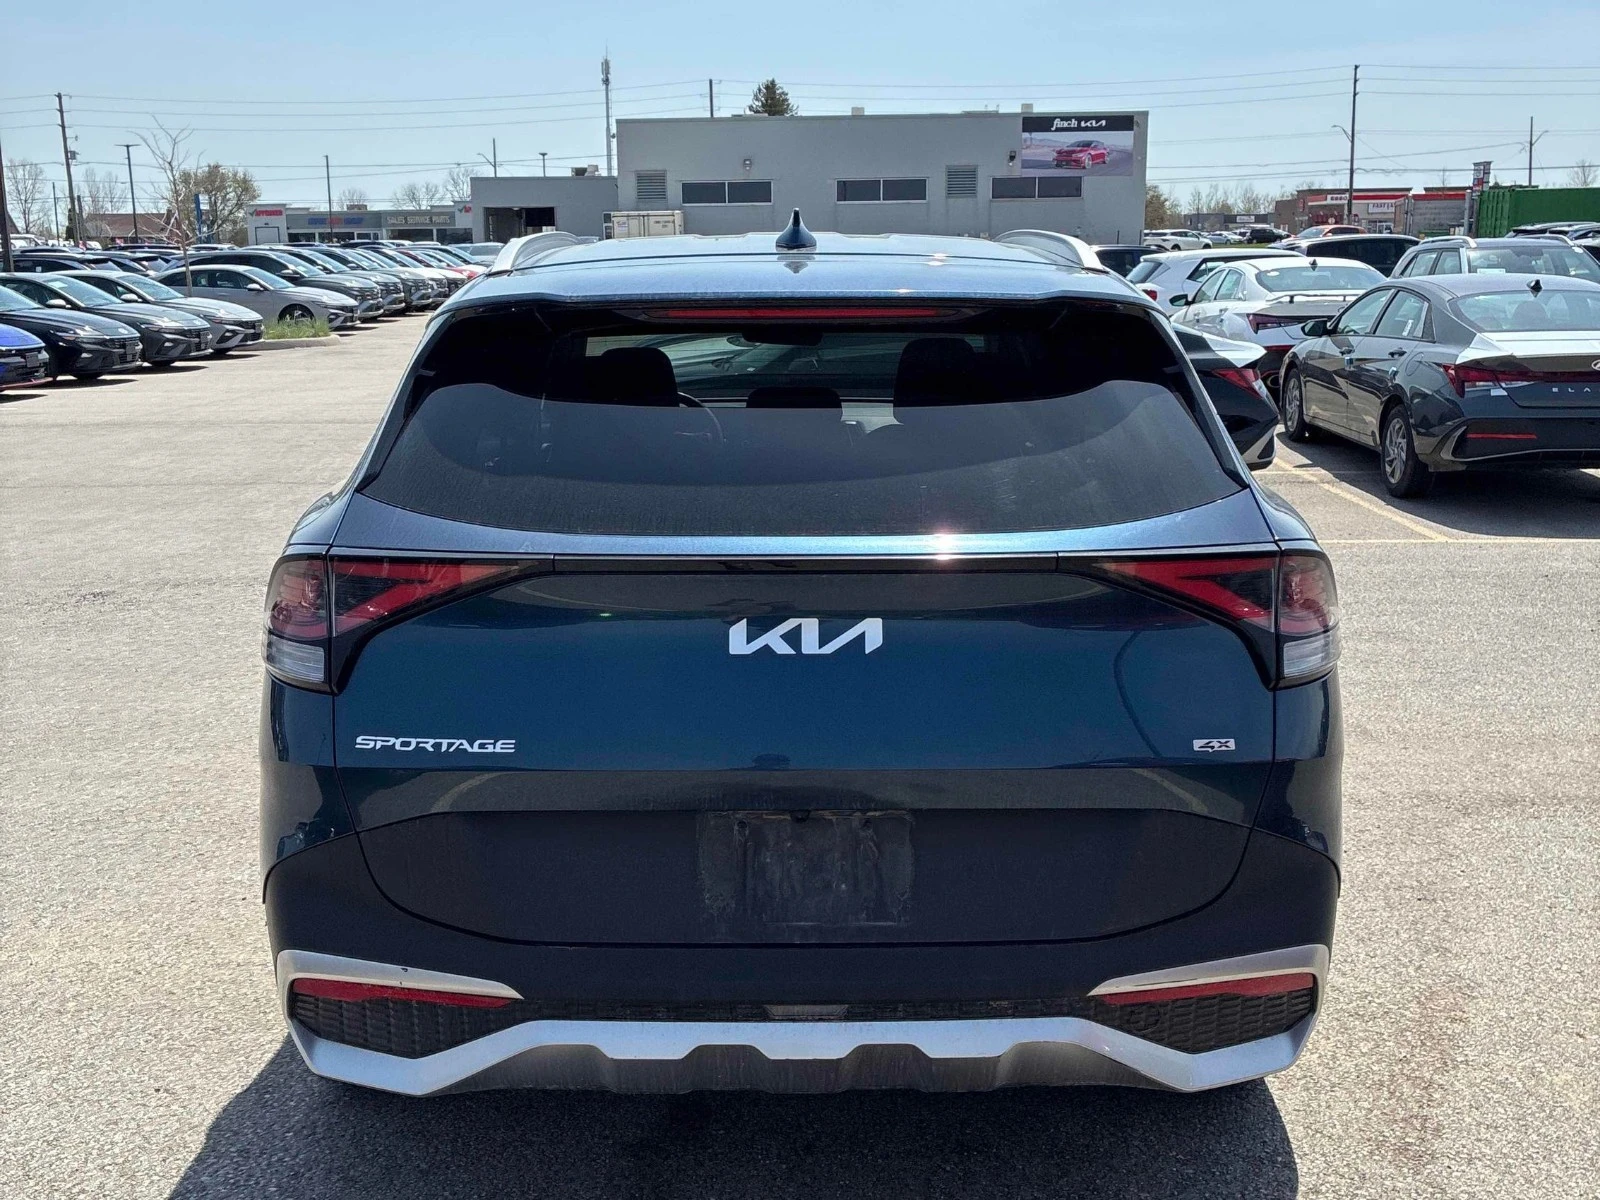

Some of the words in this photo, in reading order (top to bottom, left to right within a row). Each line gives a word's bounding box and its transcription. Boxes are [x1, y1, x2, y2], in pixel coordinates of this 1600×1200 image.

[1051, 118, 1077, 130] finch
[386, 216, 405, 224] SALES
[407, 216, 431, 224] SERVICE
[729, 617, 883, 654] KIA
[355, 735, 516, 753] SPORTAGE
